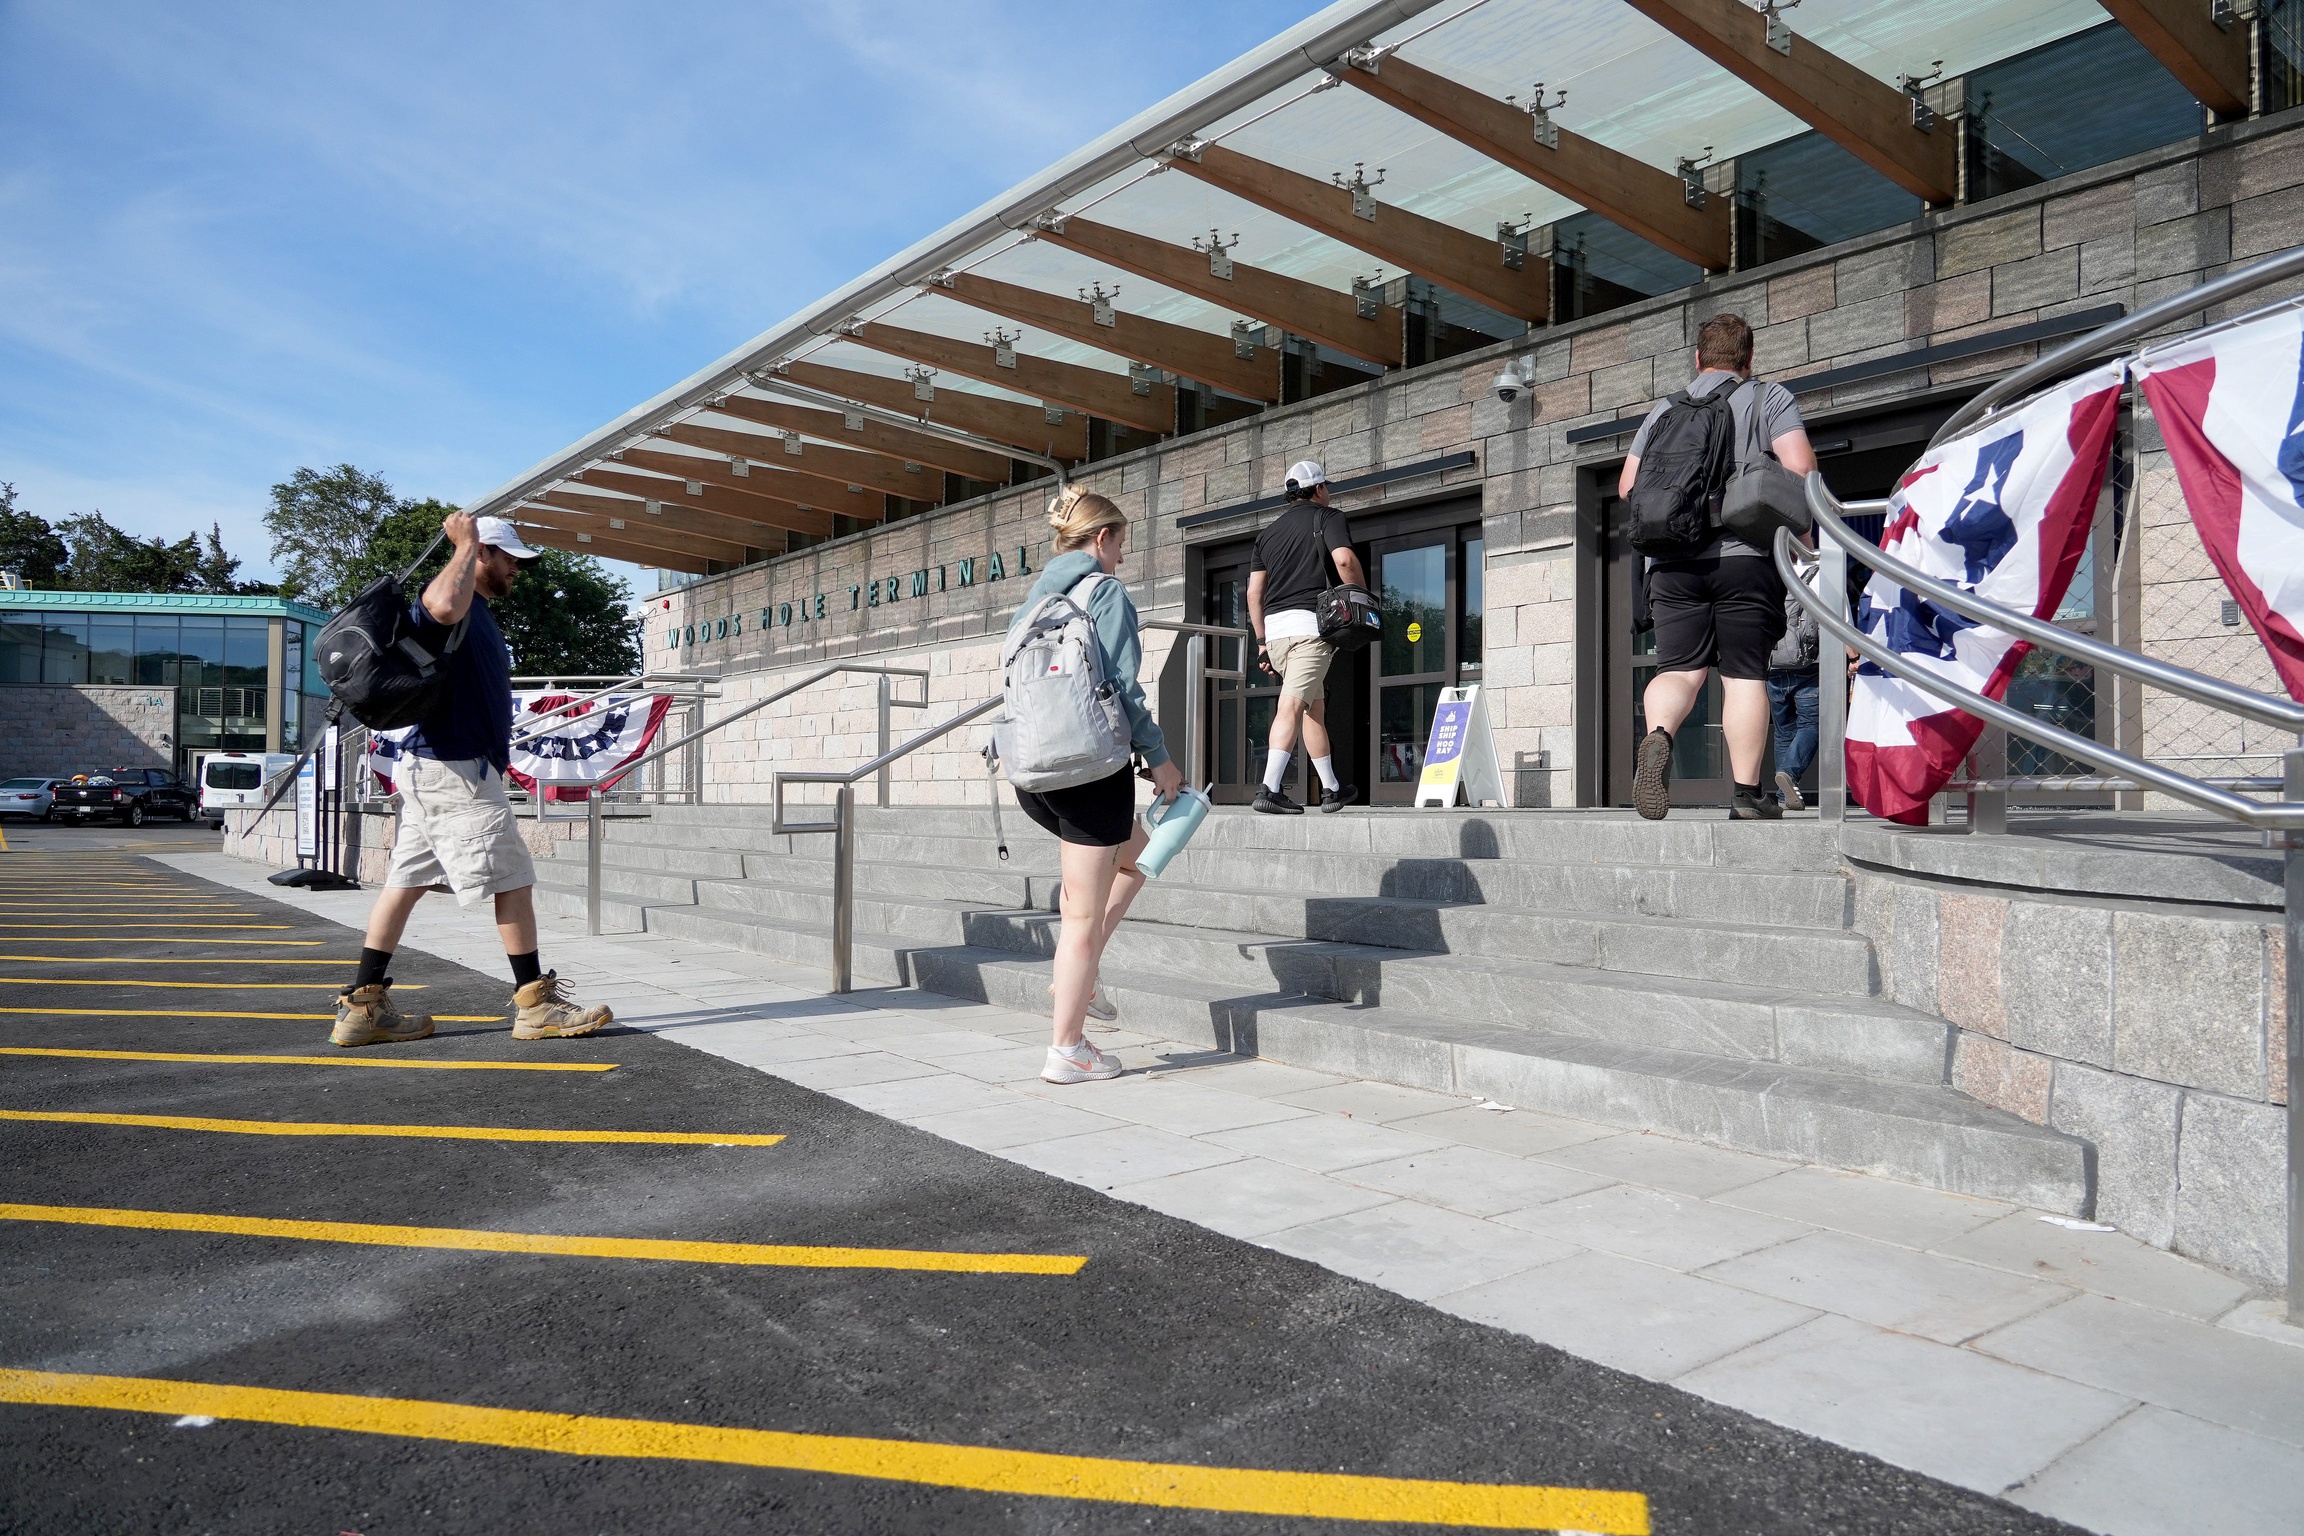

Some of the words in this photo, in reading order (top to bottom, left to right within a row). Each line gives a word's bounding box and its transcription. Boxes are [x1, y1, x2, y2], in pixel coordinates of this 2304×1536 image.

[668, 613, 742, 650] WOODS
[761, 594, 826, 630] HOLE
[848, 545, 1032, 612] TERMINAL
[1440, 725, 1458, 733] SHIP
[1436, 740, 1455, 748] HOO
